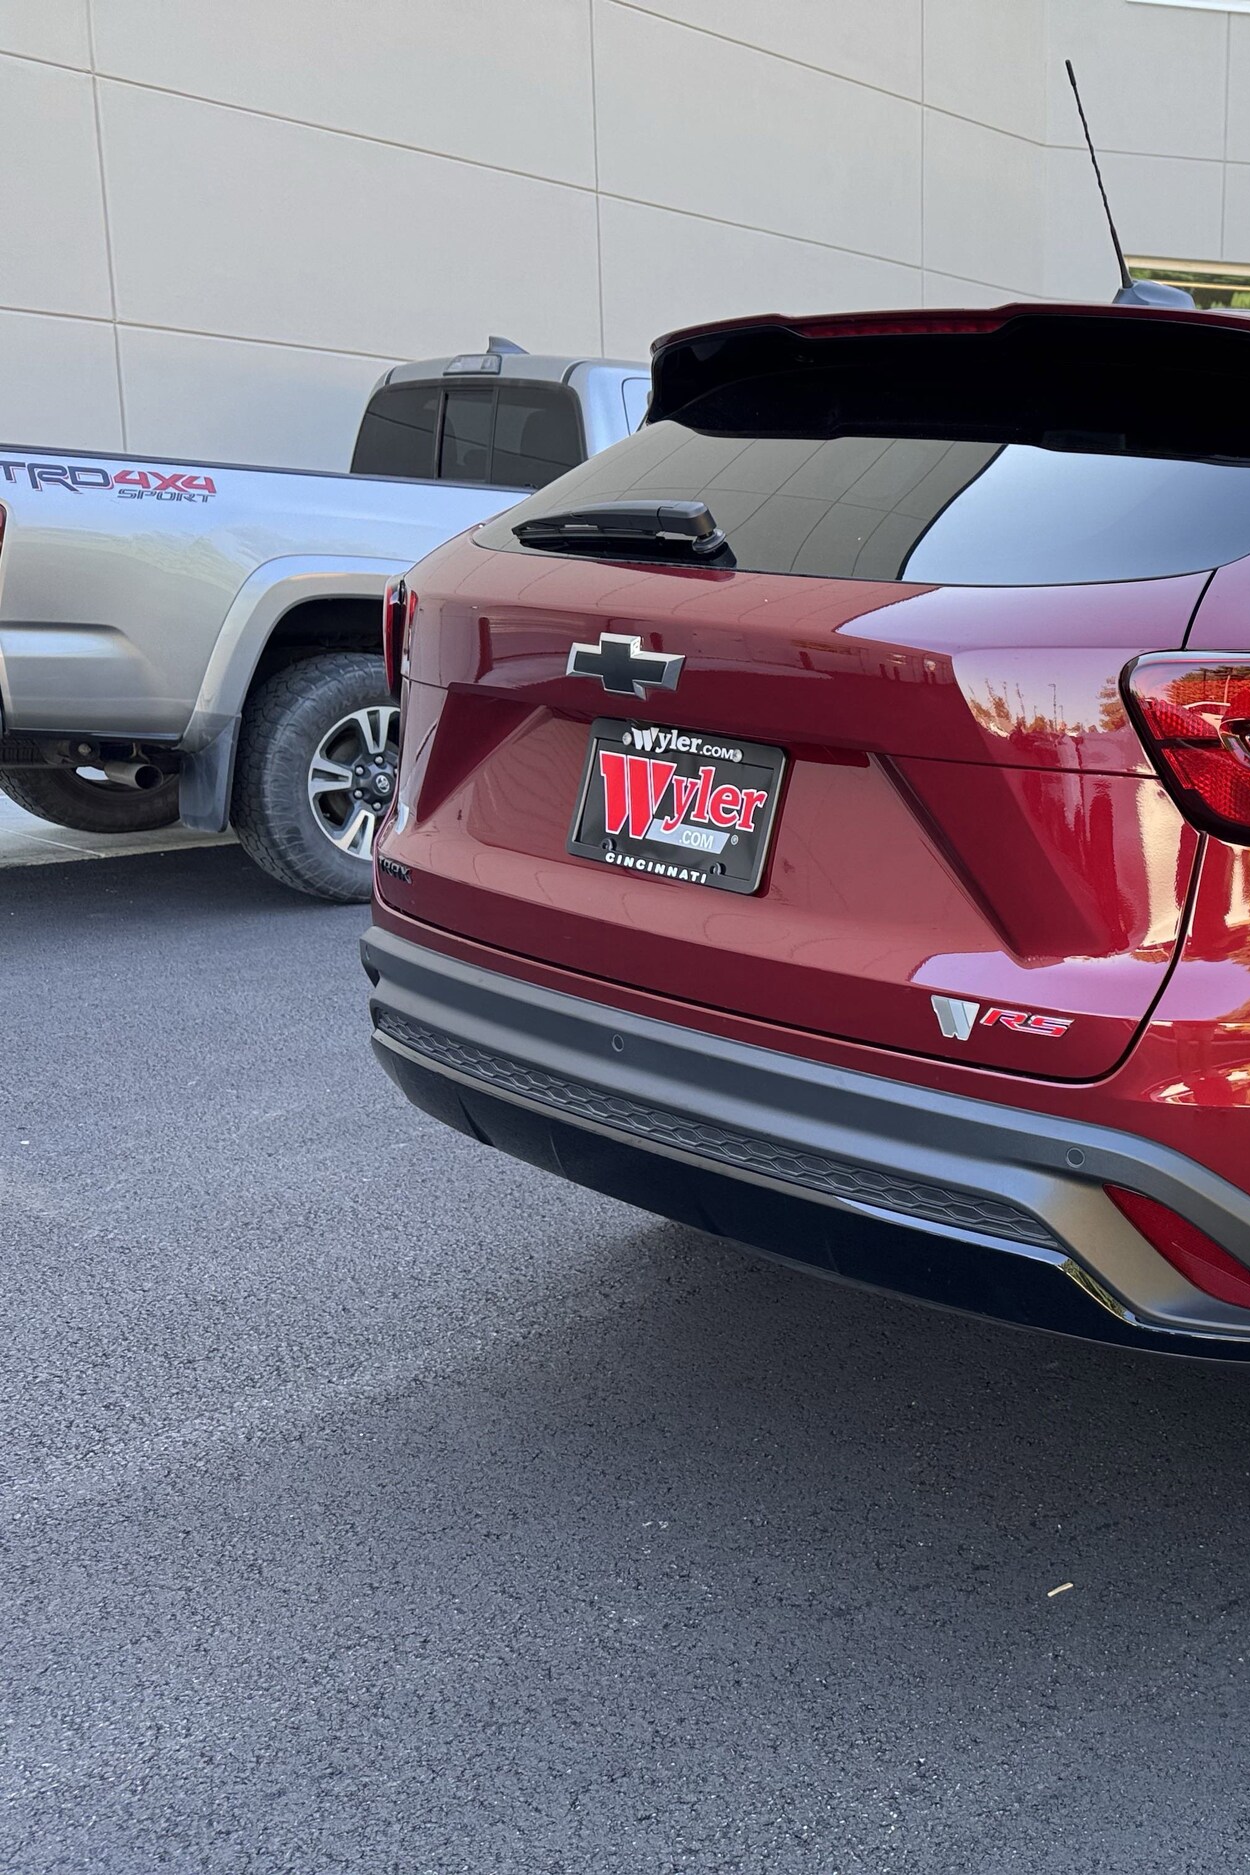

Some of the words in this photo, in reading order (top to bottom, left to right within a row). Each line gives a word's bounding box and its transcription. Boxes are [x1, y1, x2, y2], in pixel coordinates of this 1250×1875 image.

[117, 488, 216, 504] SPORT
[599, 750, 768, 840] Wyler
[605, 852, 707, 885] CINCINNATI
[979, 1007, 1076, 1037] RS
